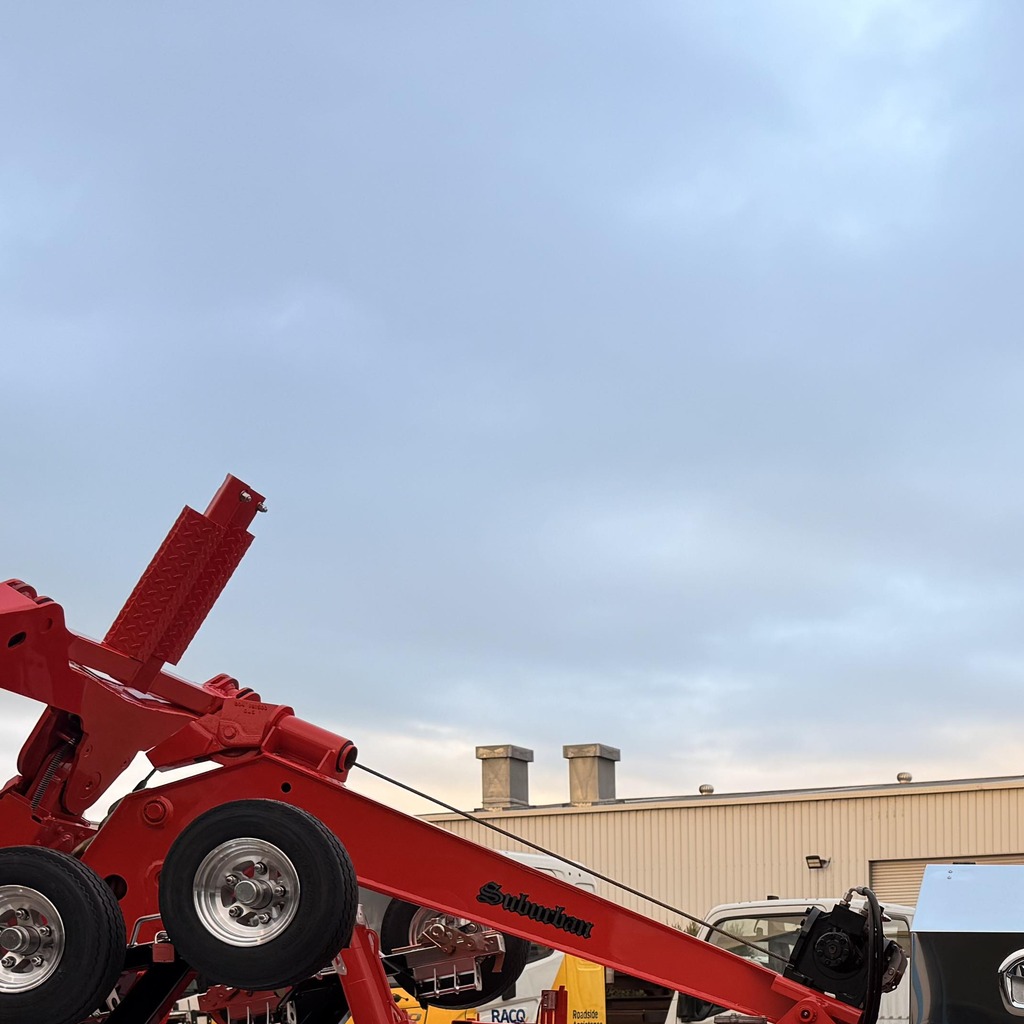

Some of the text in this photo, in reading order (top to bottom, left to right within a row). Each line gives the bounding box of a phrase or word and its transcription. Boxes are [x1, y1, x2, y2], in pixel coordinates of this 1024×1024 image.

[476, 881, 594, 939] Suburban
[492, 1009, 526, 1023] RACQ
[572, 1009, 598, 1019] Roadside
